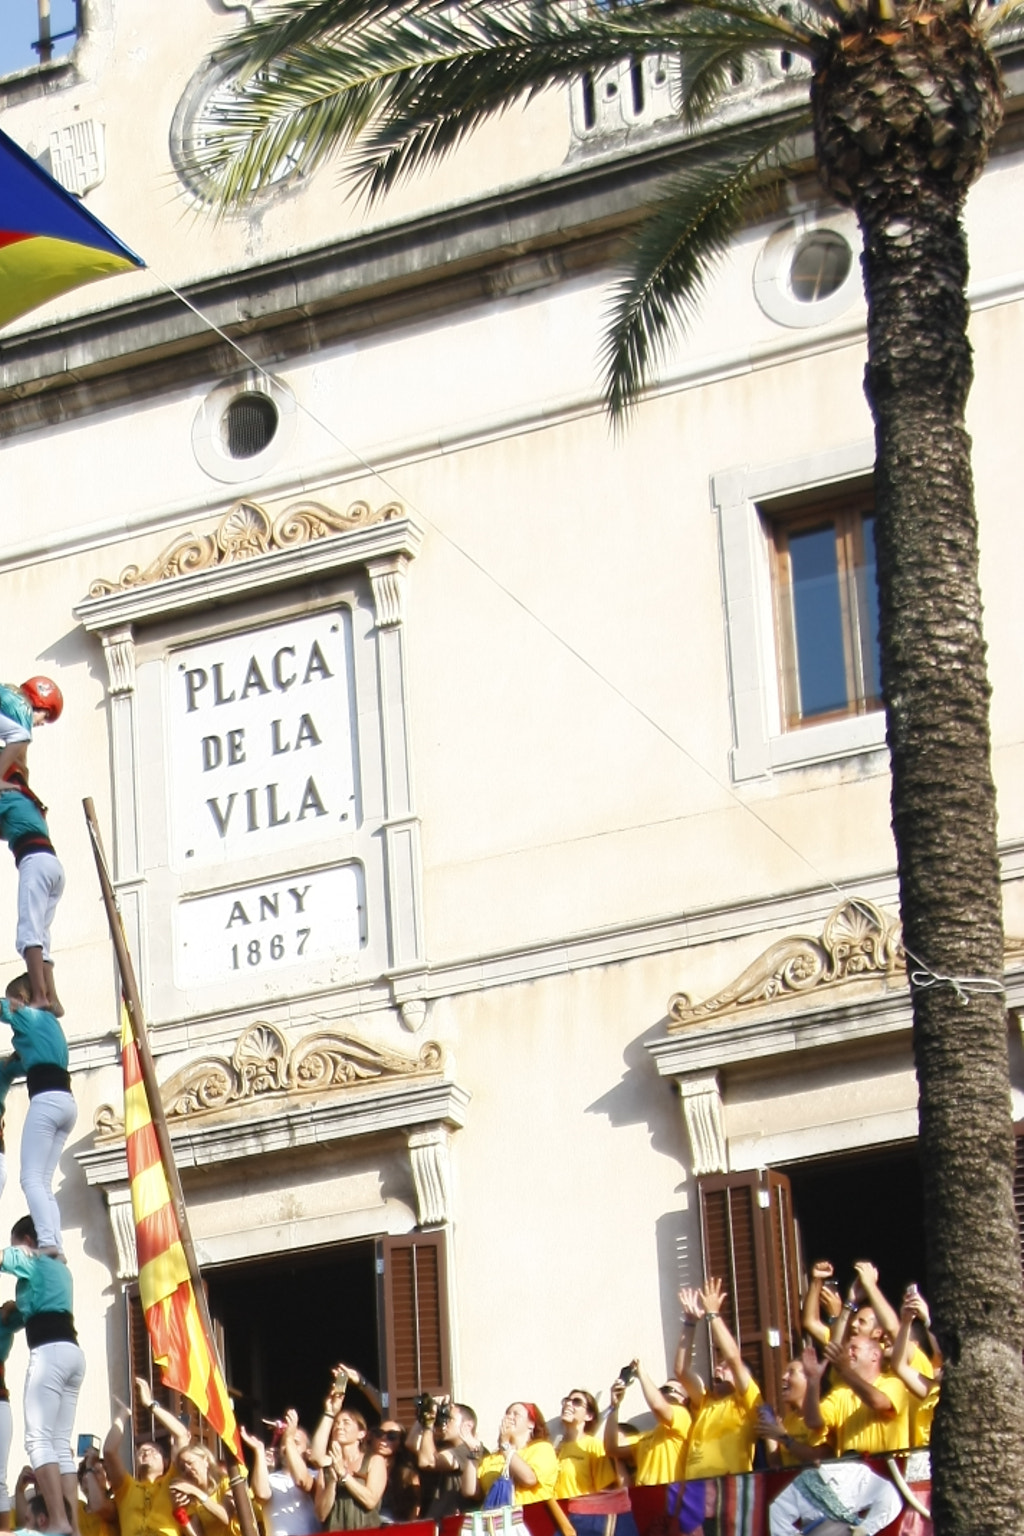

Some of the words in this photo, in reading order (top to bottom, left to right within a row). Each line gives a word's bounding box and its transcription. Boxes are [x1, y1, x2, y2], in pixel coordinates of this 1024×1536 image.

[183, 640, 334, 713] PLAÇA
[201, 728, 246, 772] DE
[270, 713, 322, 756] LA
[205, 776, 329, 839] VILA
[225, 886, 311, 930] ANY
[231, 929, 311, 970] 1867
